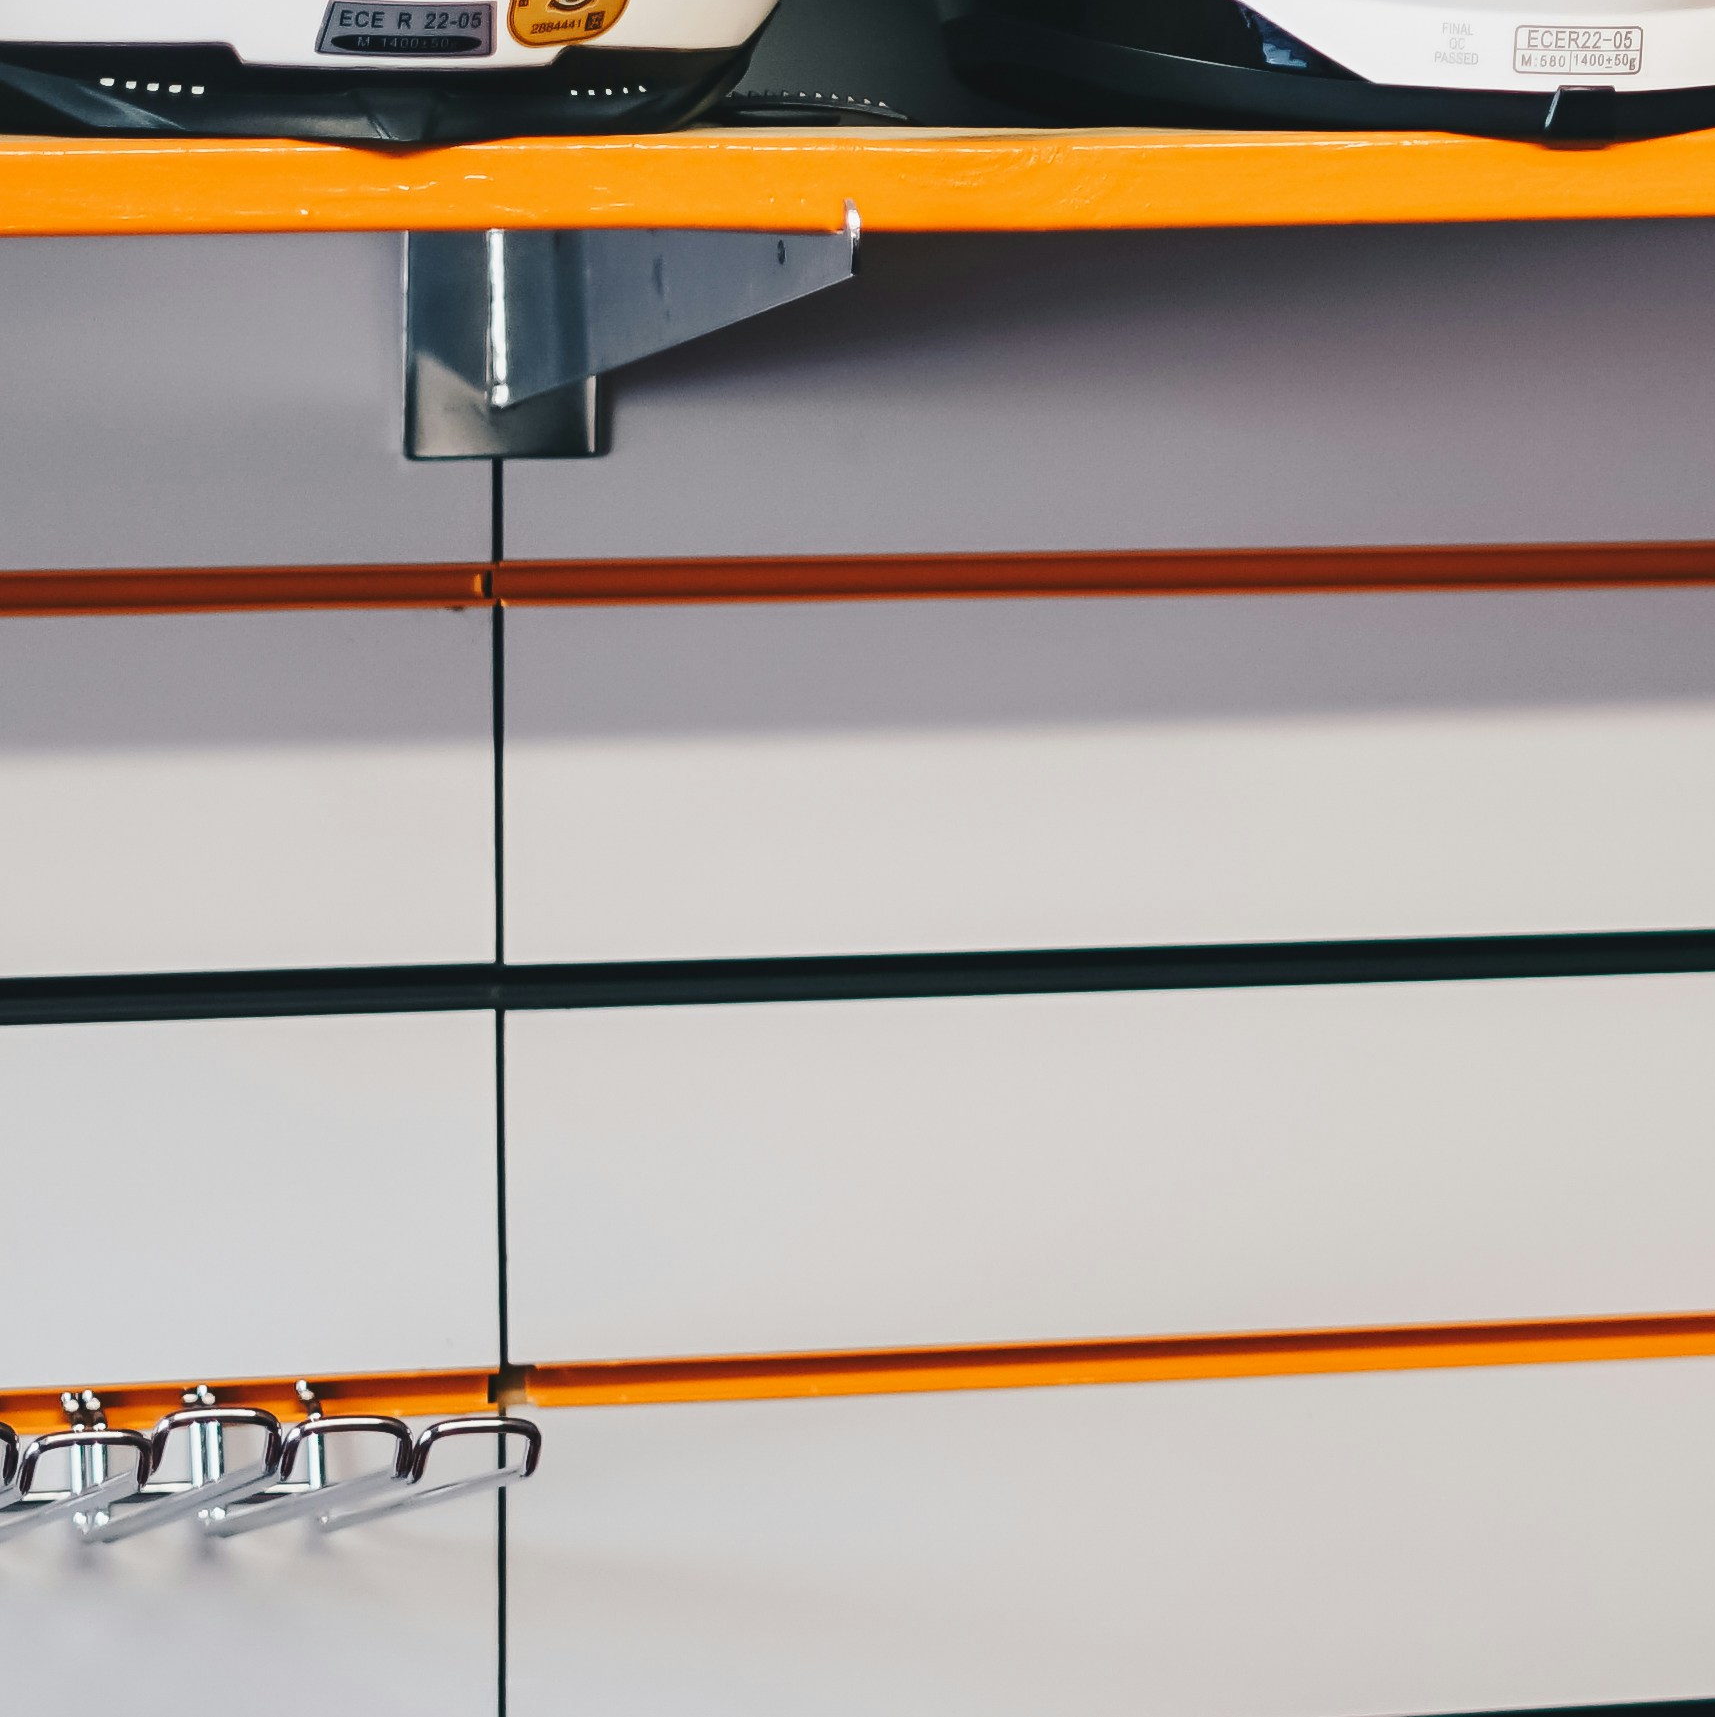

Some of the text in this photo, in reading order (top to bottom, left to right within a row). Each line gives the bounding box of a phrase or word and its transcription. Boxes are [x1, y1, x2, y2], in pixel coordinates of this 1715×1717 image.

[339, 10, 483, 29] ECE R 22-05
[1442, 22, 1474, 36] FINAL
[357, 36, 370, 47] M
[1527, 29, 1633, 49] ECER22-05
[1434, 51, 1479, 65] PASSED
